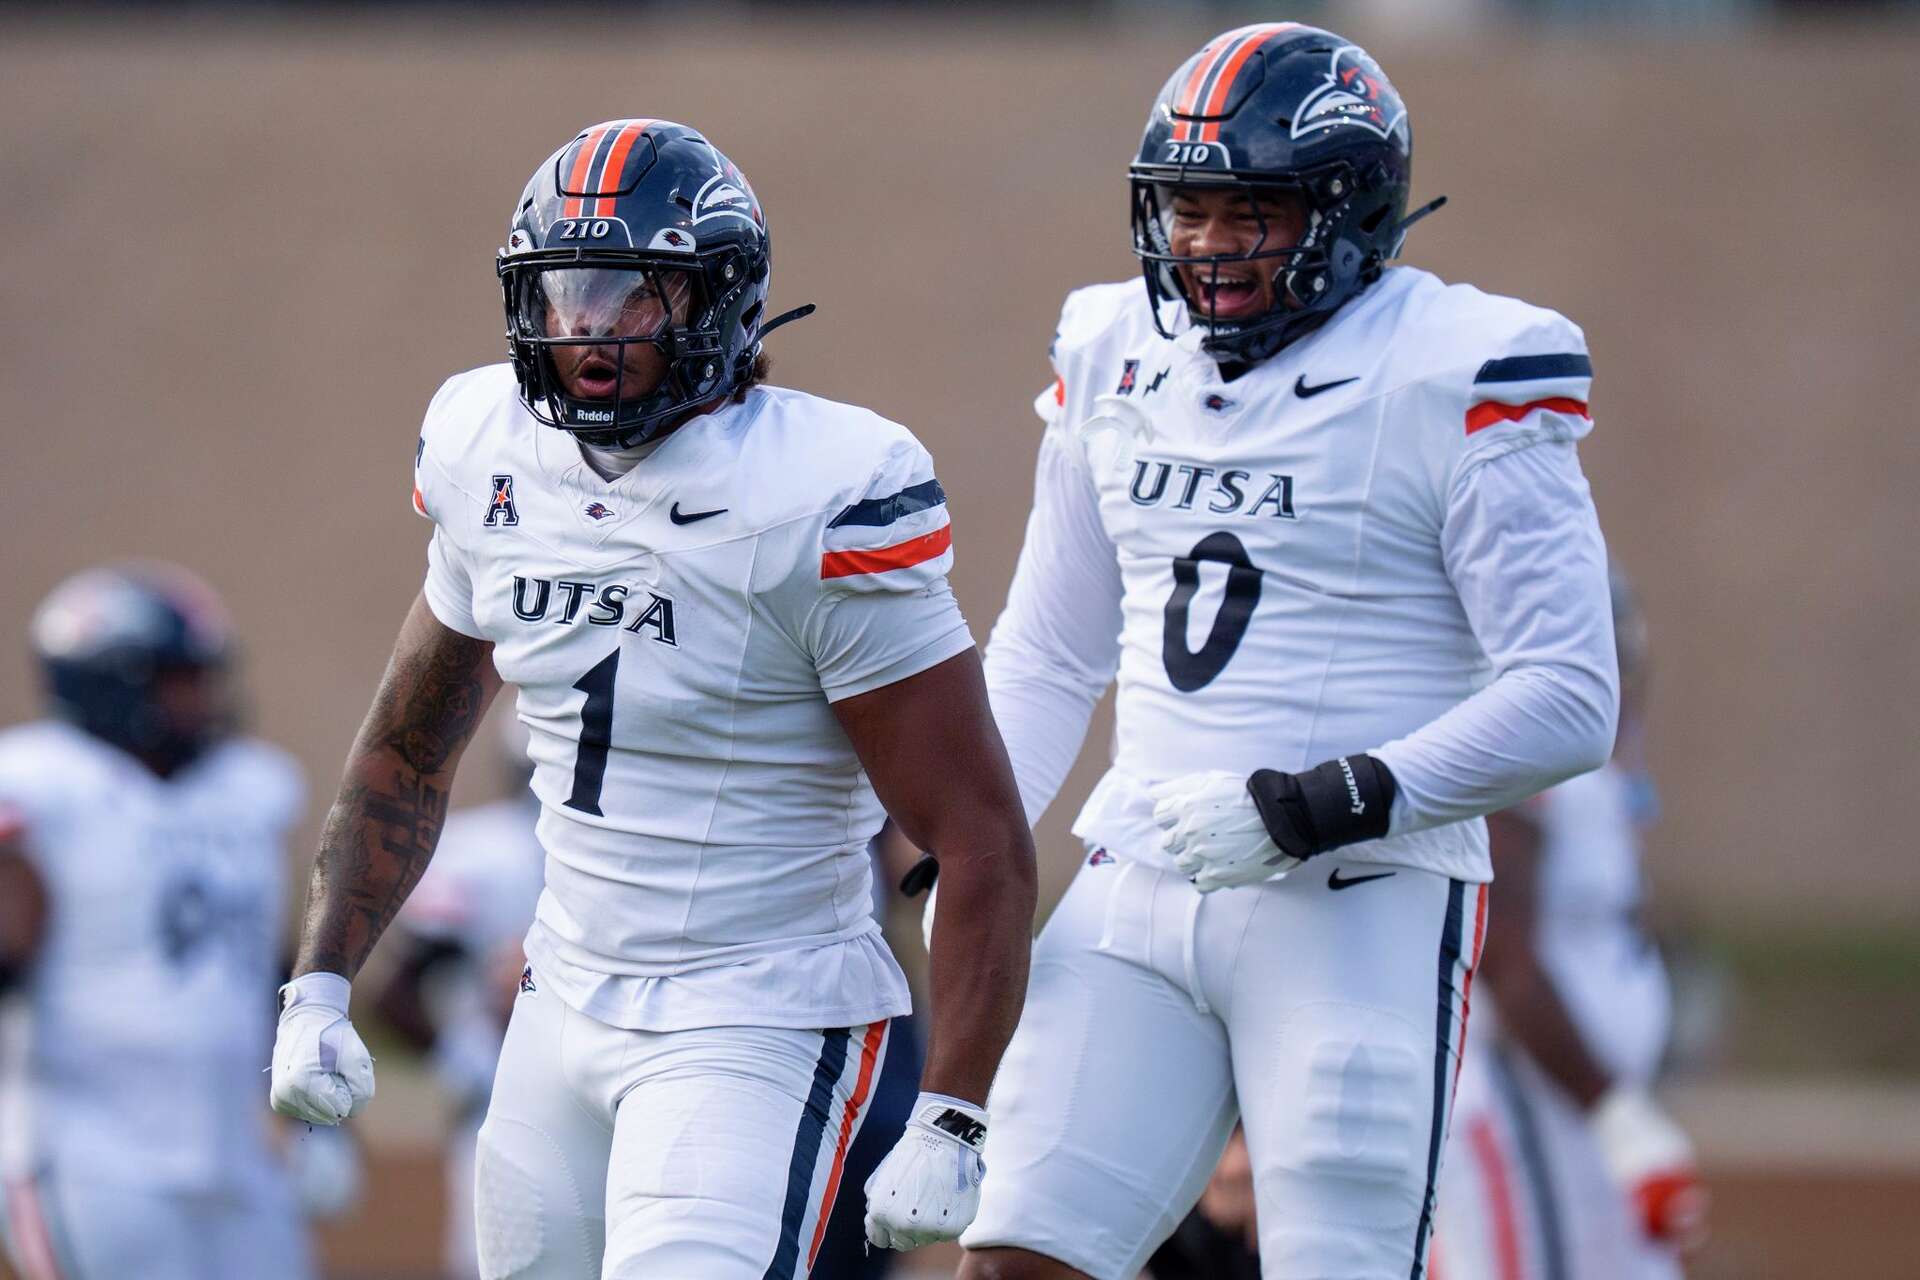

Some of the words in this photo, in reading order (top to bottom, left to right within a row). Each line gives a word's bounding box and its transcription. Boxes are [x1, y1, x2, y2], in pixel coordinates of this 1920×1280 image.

[1166, 144, 1208, 163] 210
[561, 219, 609, 240] 210
[577, 410, 614, 421] Riddel
[1131, 460, 1296, 518] UTSA
[513, 576, 678, 646] UTSA
[1162, 531, 1264, 692] 0
[562, 647, 620, 816] 1
[933, 1108, 987, 1146] NIKE
